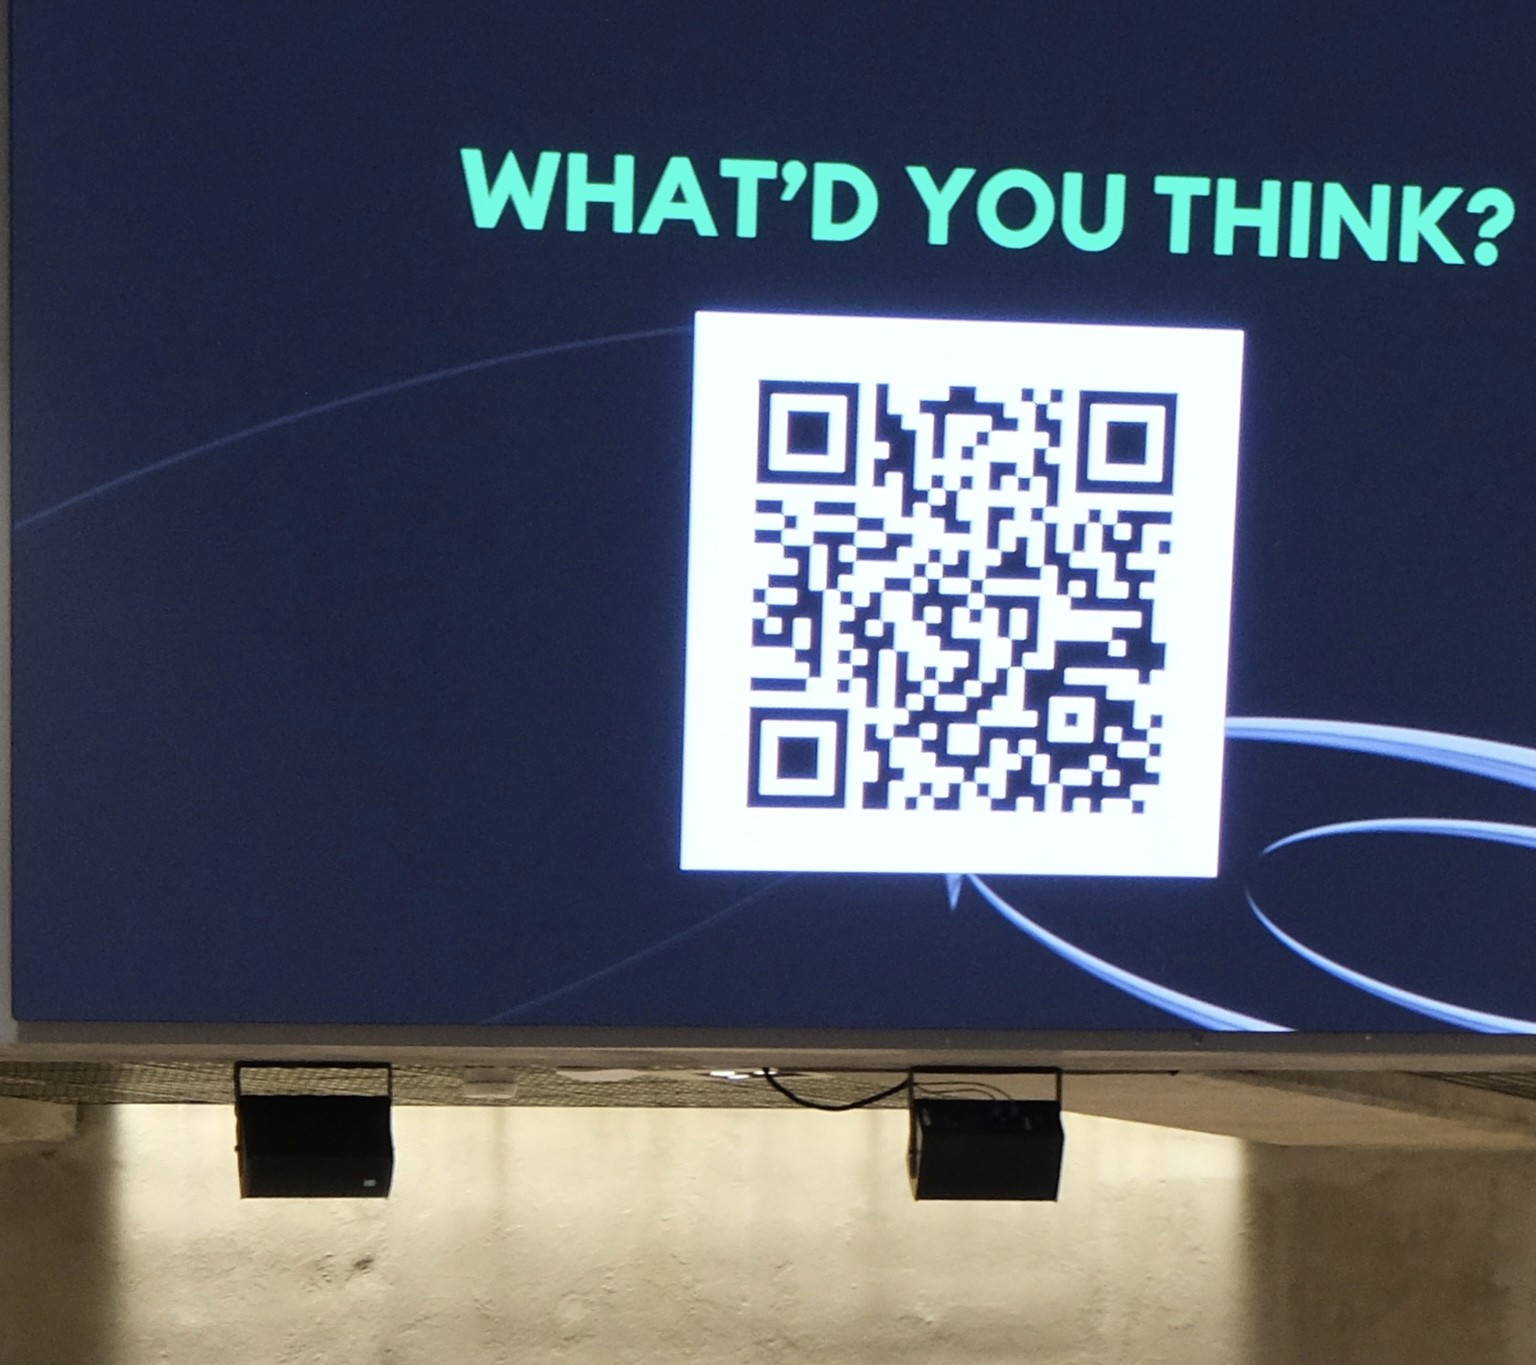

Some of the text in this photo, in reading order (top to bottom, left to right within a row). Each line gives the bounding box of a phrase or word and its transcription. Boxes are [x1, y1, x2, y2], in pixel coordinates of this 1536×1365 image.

[459, 148, 1516, 268] WHAT'D YOU THINK?
